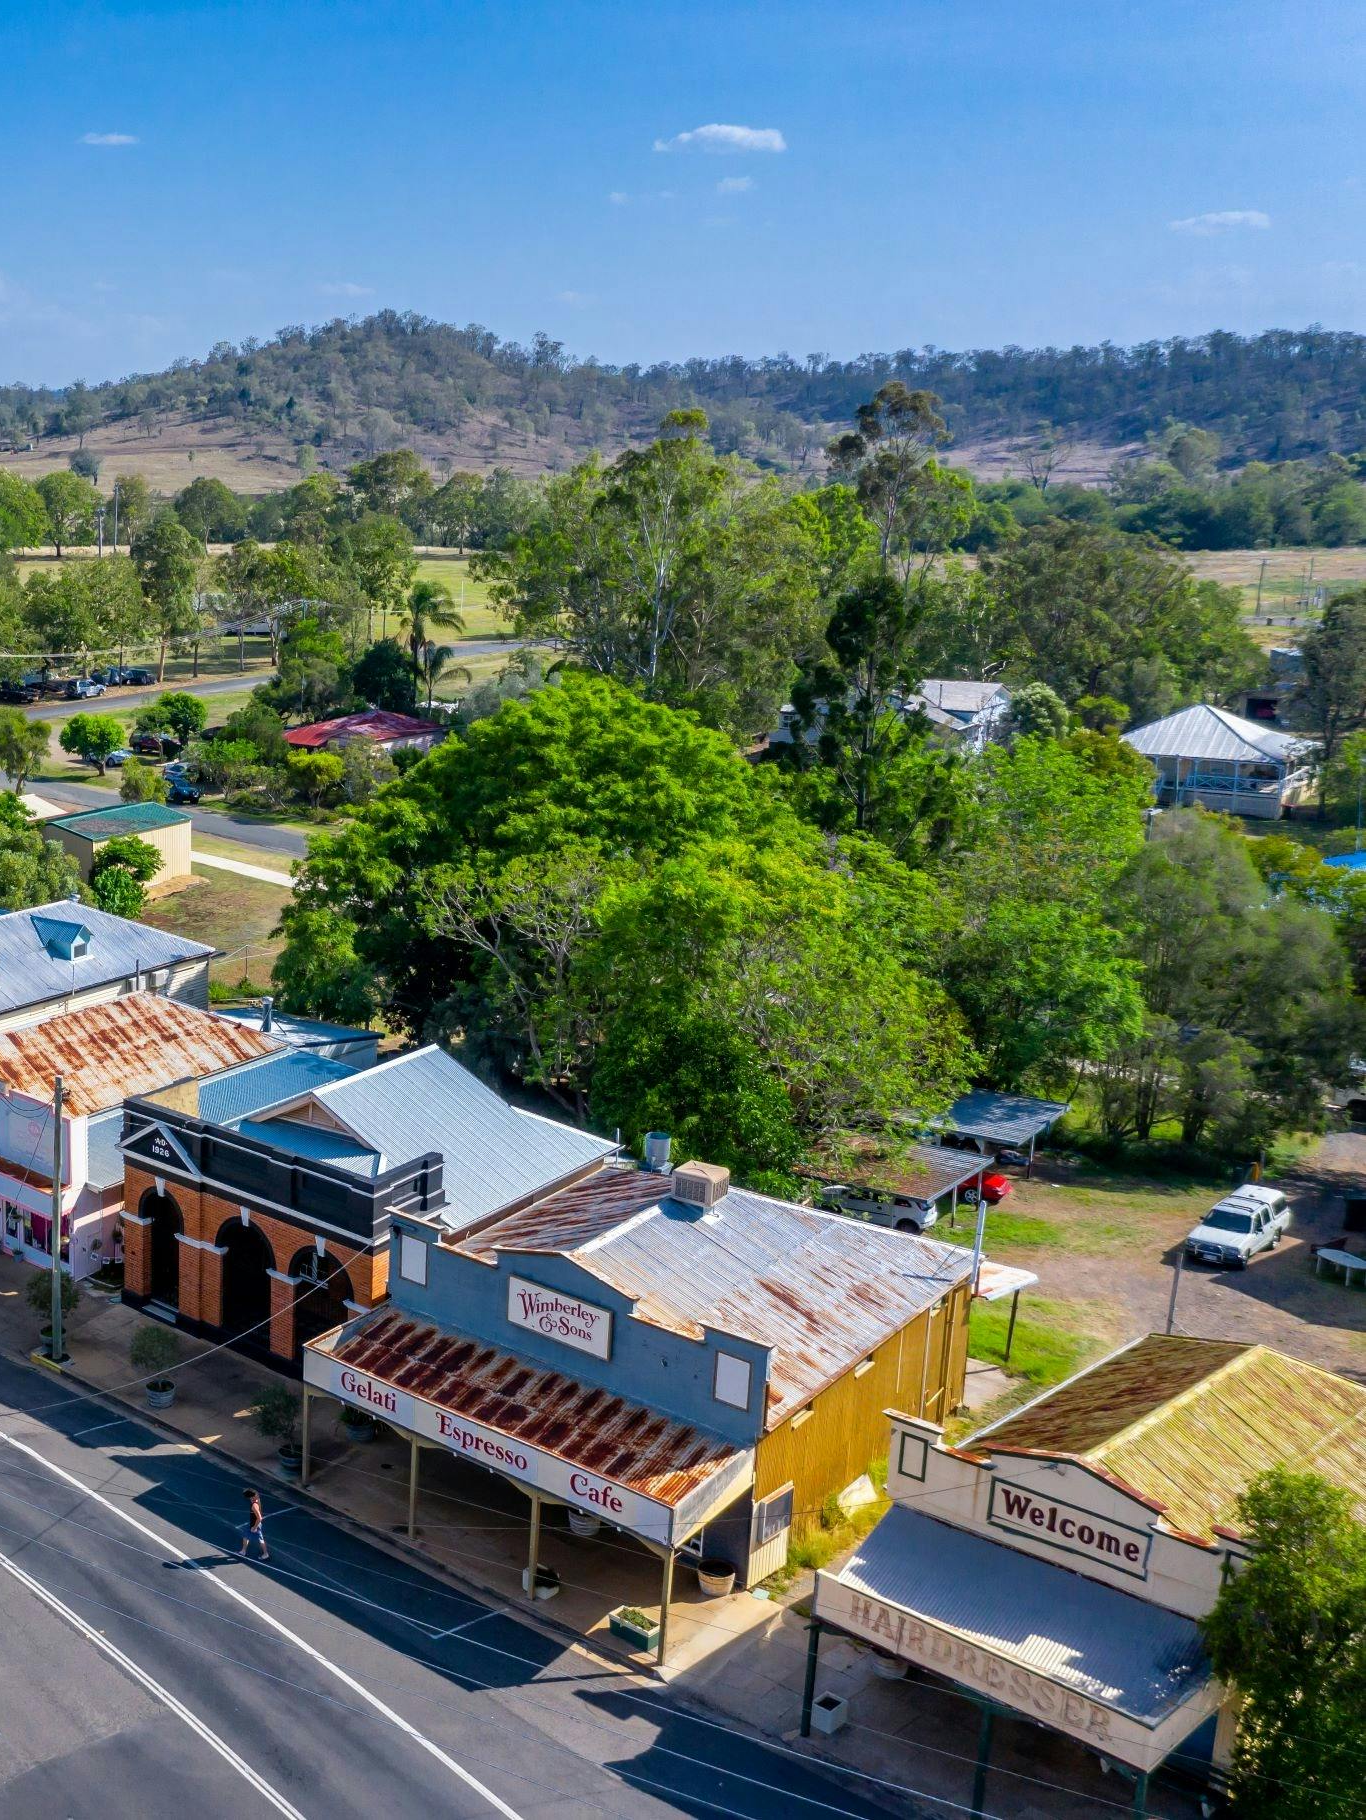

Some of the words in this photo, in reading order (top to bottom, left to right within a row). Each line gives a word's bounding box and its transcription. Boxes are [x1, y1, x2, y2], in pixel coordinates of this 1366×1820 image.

[152, 1144, 170, 1158] 1926
[517, 1288, 600, 1329] Wimberley
[539, 1313, 557, 1333] &
[558, 1316, 592, 1341] Sons
[341, 1371, 397, 1413] Gelati
[435, 1411, 528, 1470] Espresso
[570, 1473, 623, 1513] Cafe
[1001, 1487, 1140, 1562] Welcome
[849, 1594, 1113, 1742] HAIRDRESSER
